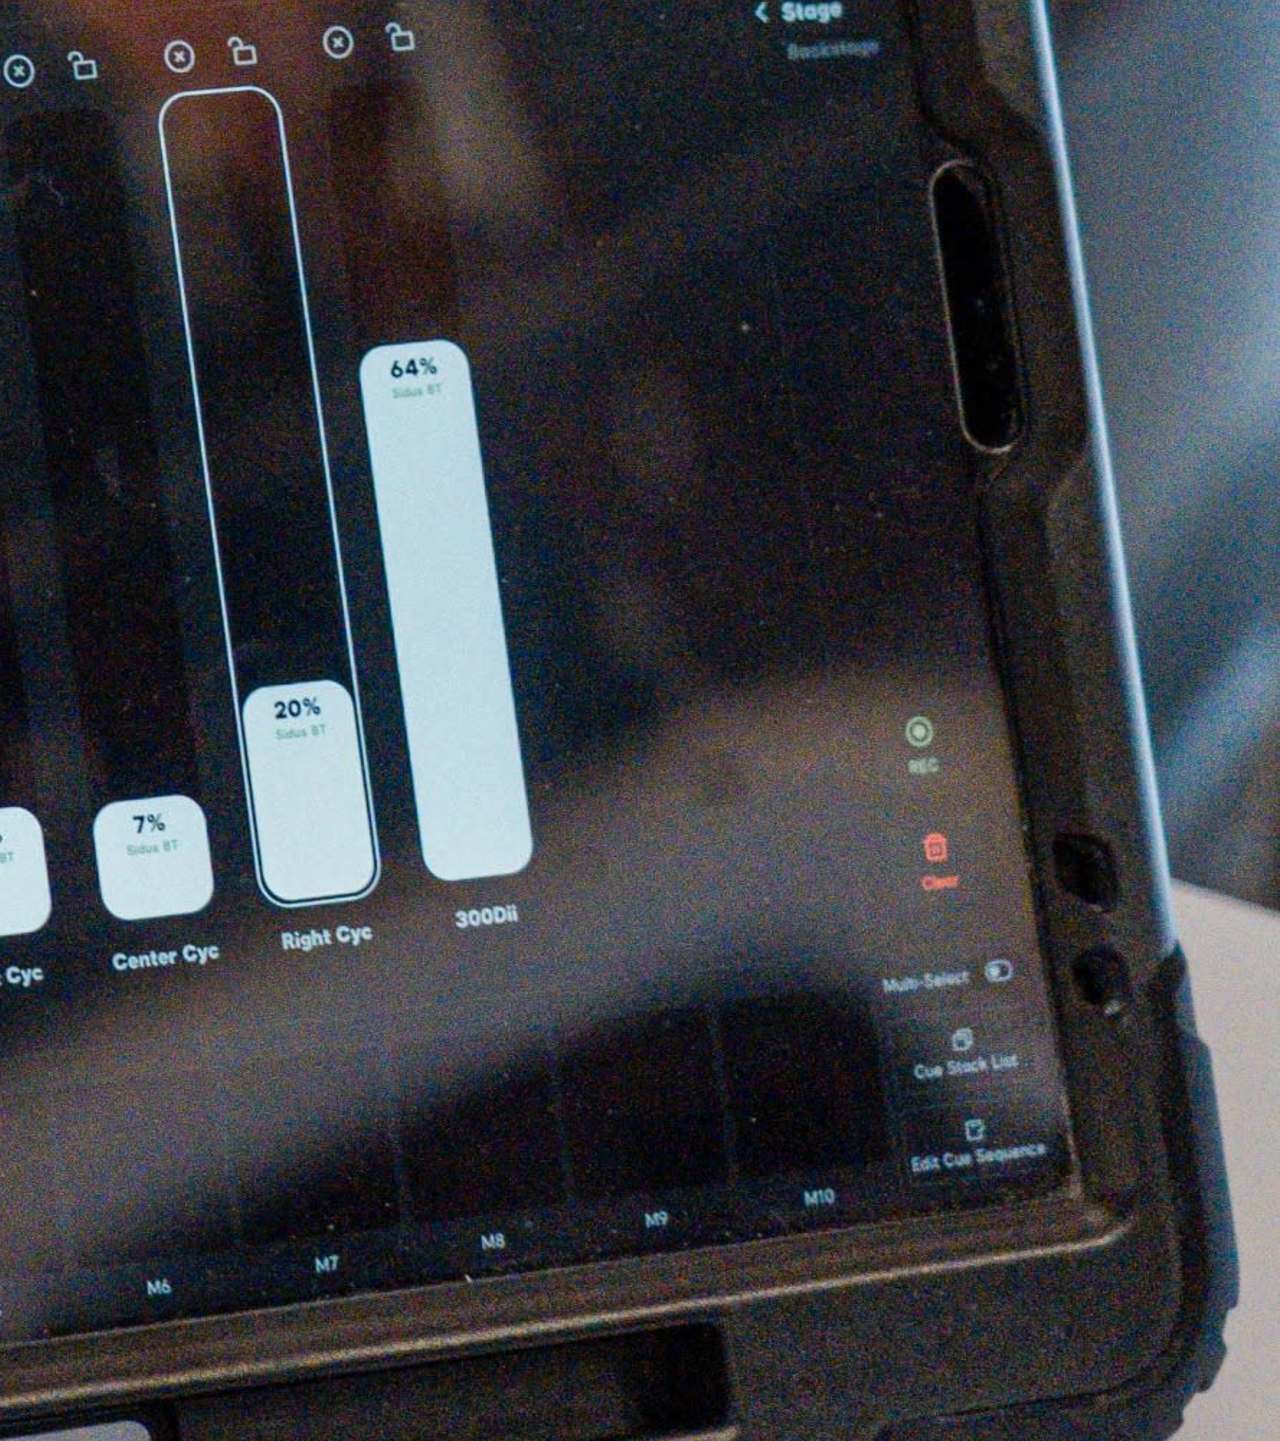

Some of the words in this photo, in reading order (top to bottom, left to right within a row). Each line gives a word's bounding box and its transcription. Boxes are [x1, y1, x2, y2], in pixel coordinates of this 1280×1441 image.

[782, 1, 842, 23] Stage
[391, 357, 437, 378] 64%
[392, 387, 424, 399] Sidus
[274, 697, 321, 719] 20%
[275, 727, 308, 741] Sidus
[133, 813, 166, 834] 7%
[127, 843, 159, 856] Sidus
[456, 905, 518, 928] 300Dii
[281, 928, 332, 951] Right
[336, 924, 373, 945] Cyc
[113, 949, 177, 971] Center
[183, 944, 220, 966] Cyc
[7, 966, 43, 987] Cyc
[914, 1064, 943, 1081] Cue
[947, 1058, 986, 1076] Stack
[943, 1150, 971, 1168] Cue
[976, 1142, 1045, 1166] Sequence
[804, 1188, 835, 1206] M10
[644, 1210, 669, 1229] M9
[480, 1233, 506, 1251] M8
[314, 1255, 340, 1274] M7
[146, 1279, 172, 1297] M6
